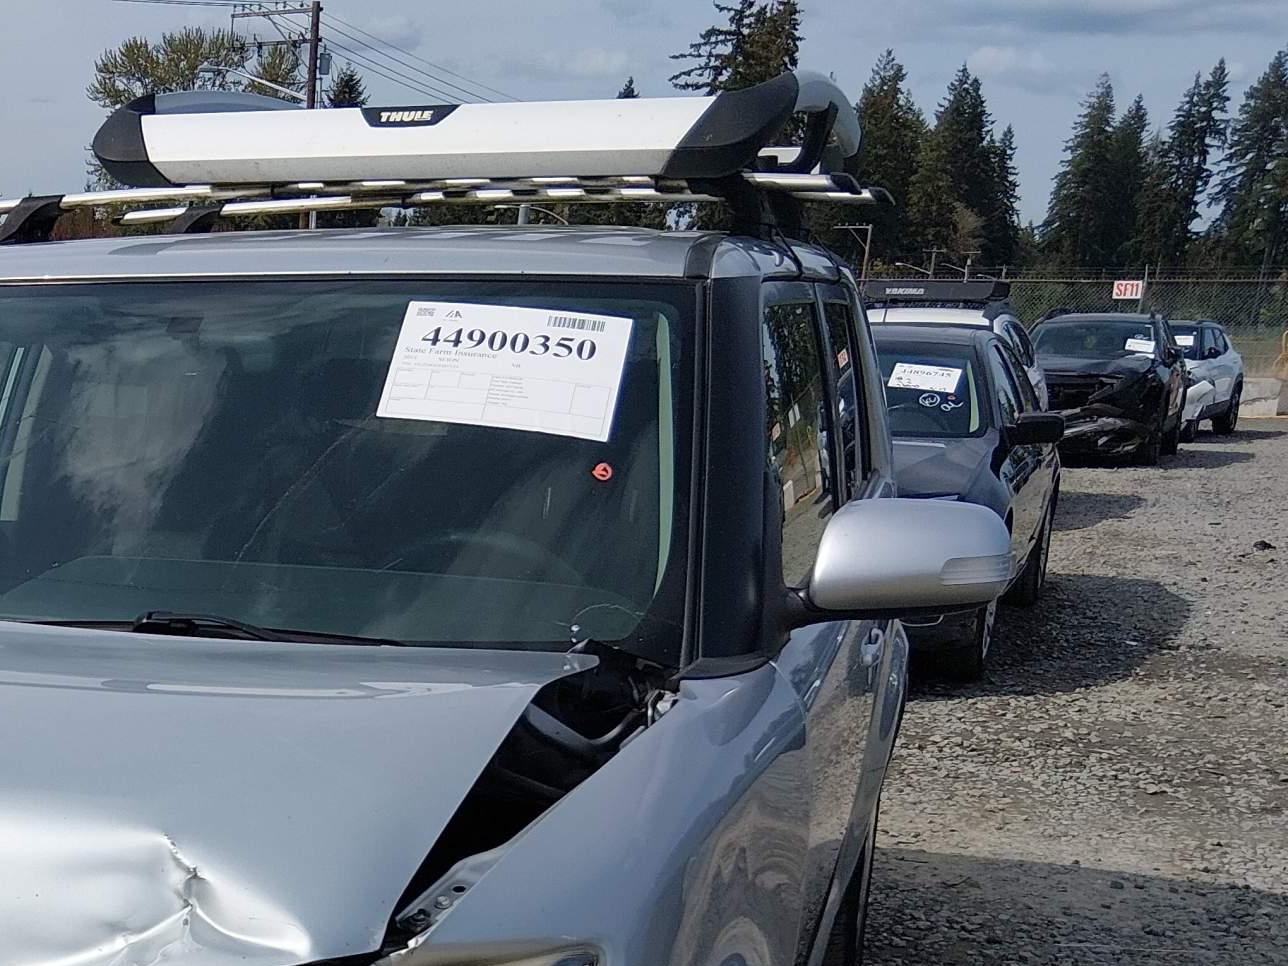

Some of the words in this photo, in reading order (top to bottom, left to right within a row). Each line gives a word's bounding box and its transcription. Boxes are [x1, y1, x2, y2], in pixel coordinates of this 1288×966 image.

[380, 110, 434, 122] THULE
[421, 326, 597, 361] 44900350
[454, 350, 497, 359] Insurance
